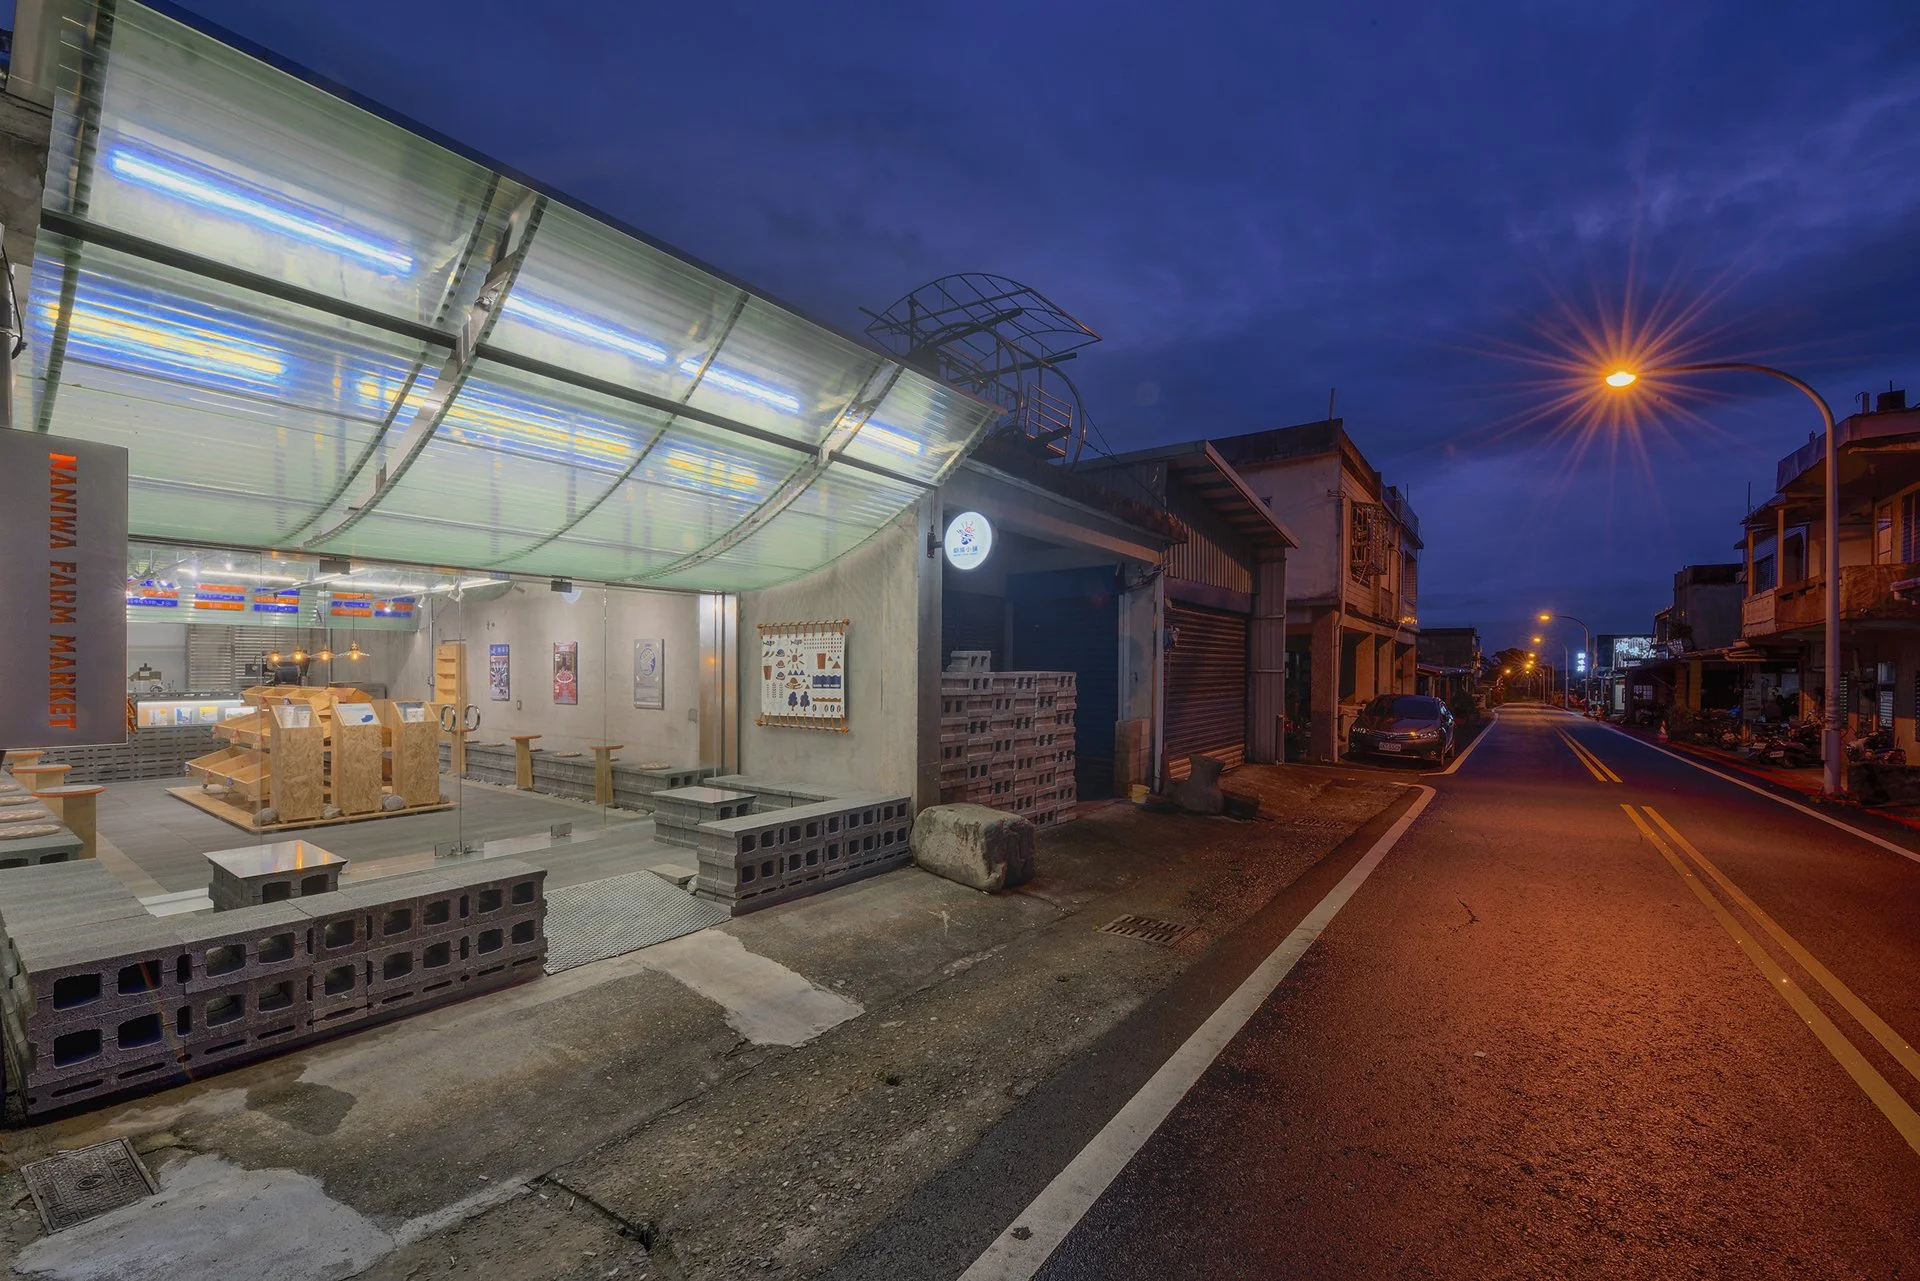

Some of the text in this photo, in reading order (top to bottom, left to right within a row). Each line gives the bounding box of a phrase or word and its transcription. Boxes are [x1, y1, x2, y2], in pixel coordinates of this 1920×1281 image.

[48, 452, 78, 730] NANIWA FARM MARKET
